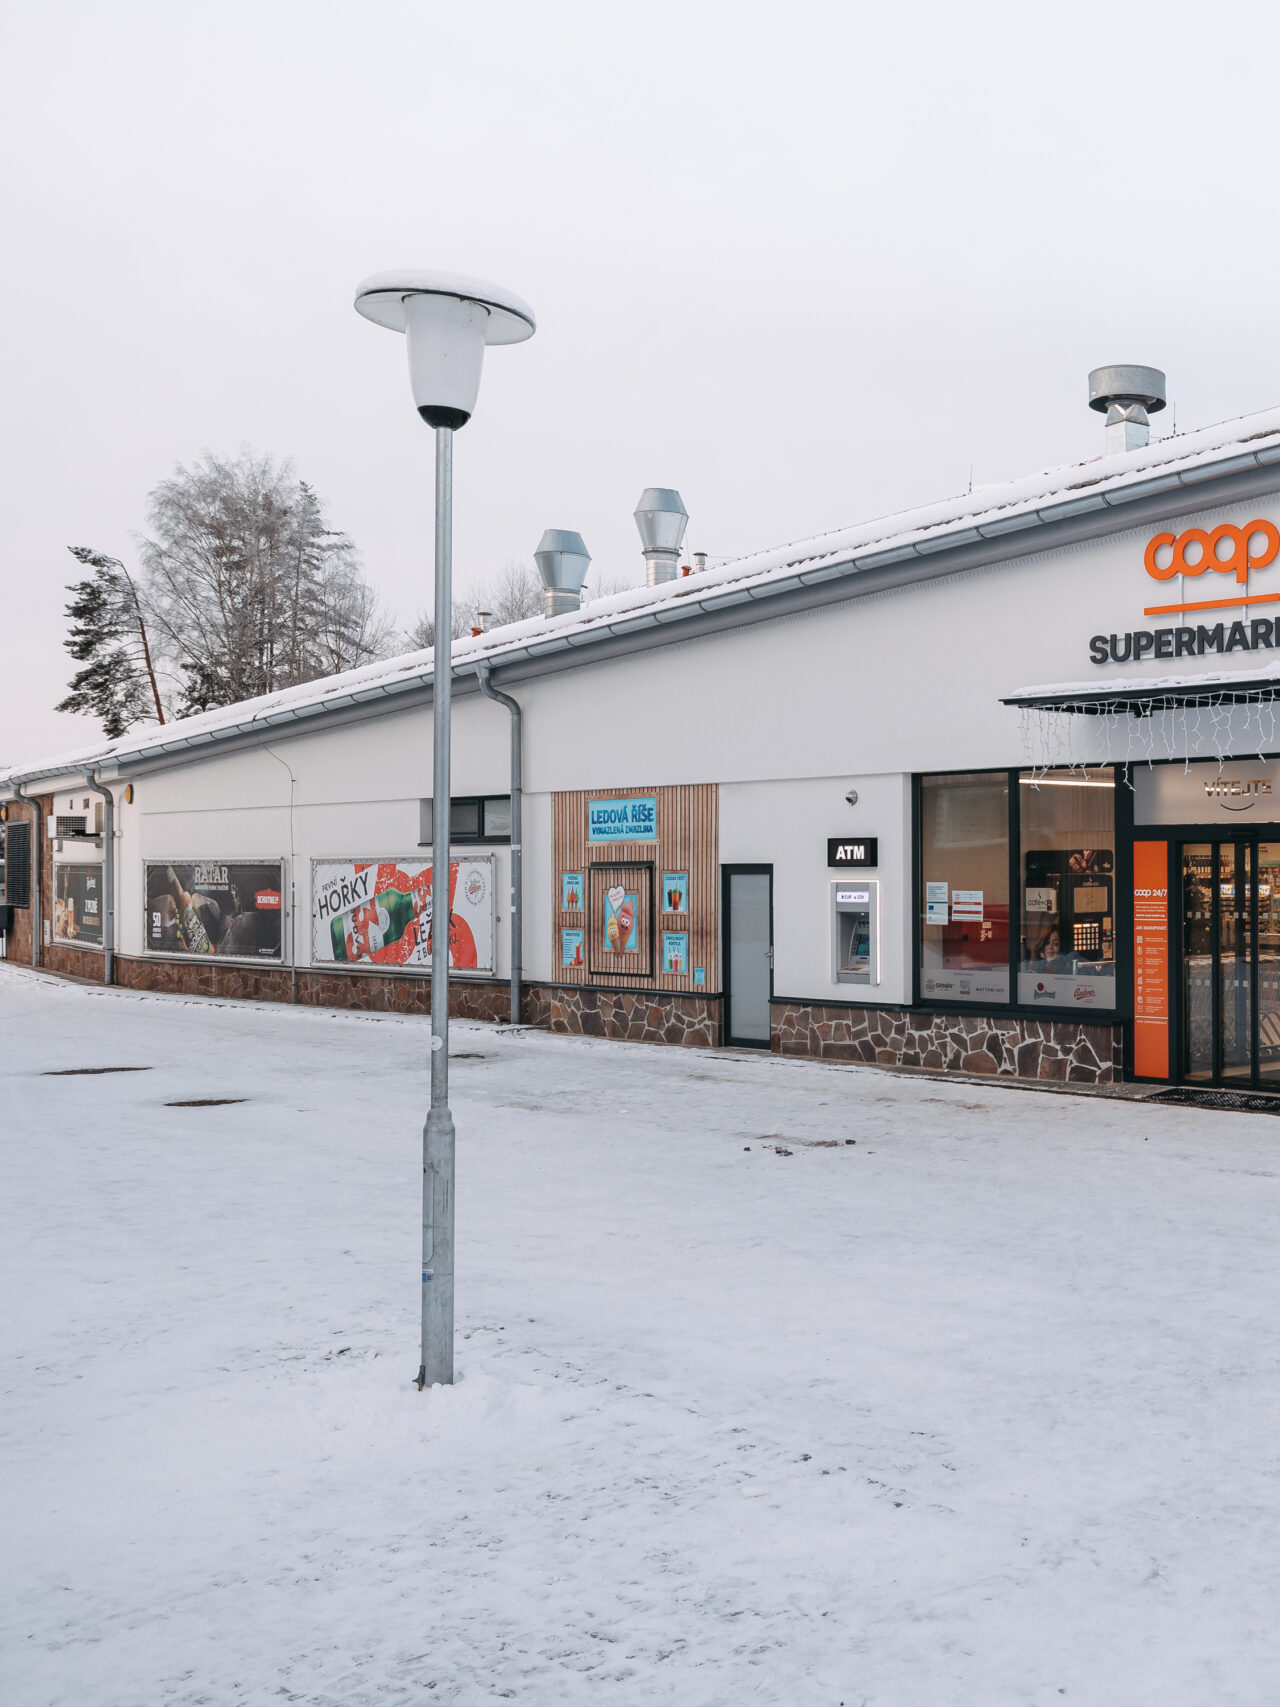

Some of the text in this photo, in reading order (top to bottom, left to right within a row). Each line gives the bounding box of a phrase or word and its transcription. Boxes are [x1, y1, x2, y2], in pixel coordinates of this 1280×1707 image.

[1144, 519, 1280, 583] coop
[1204, 777, 1272, 797] VÍTEJTE
[591, 805, 629, 825] LEDOVÁ
[835, 845, 865, 860] ATM
[318, 867, 369, 920] HOŘKÝ
[1134, 889, 1168, 898] coop 24/7
